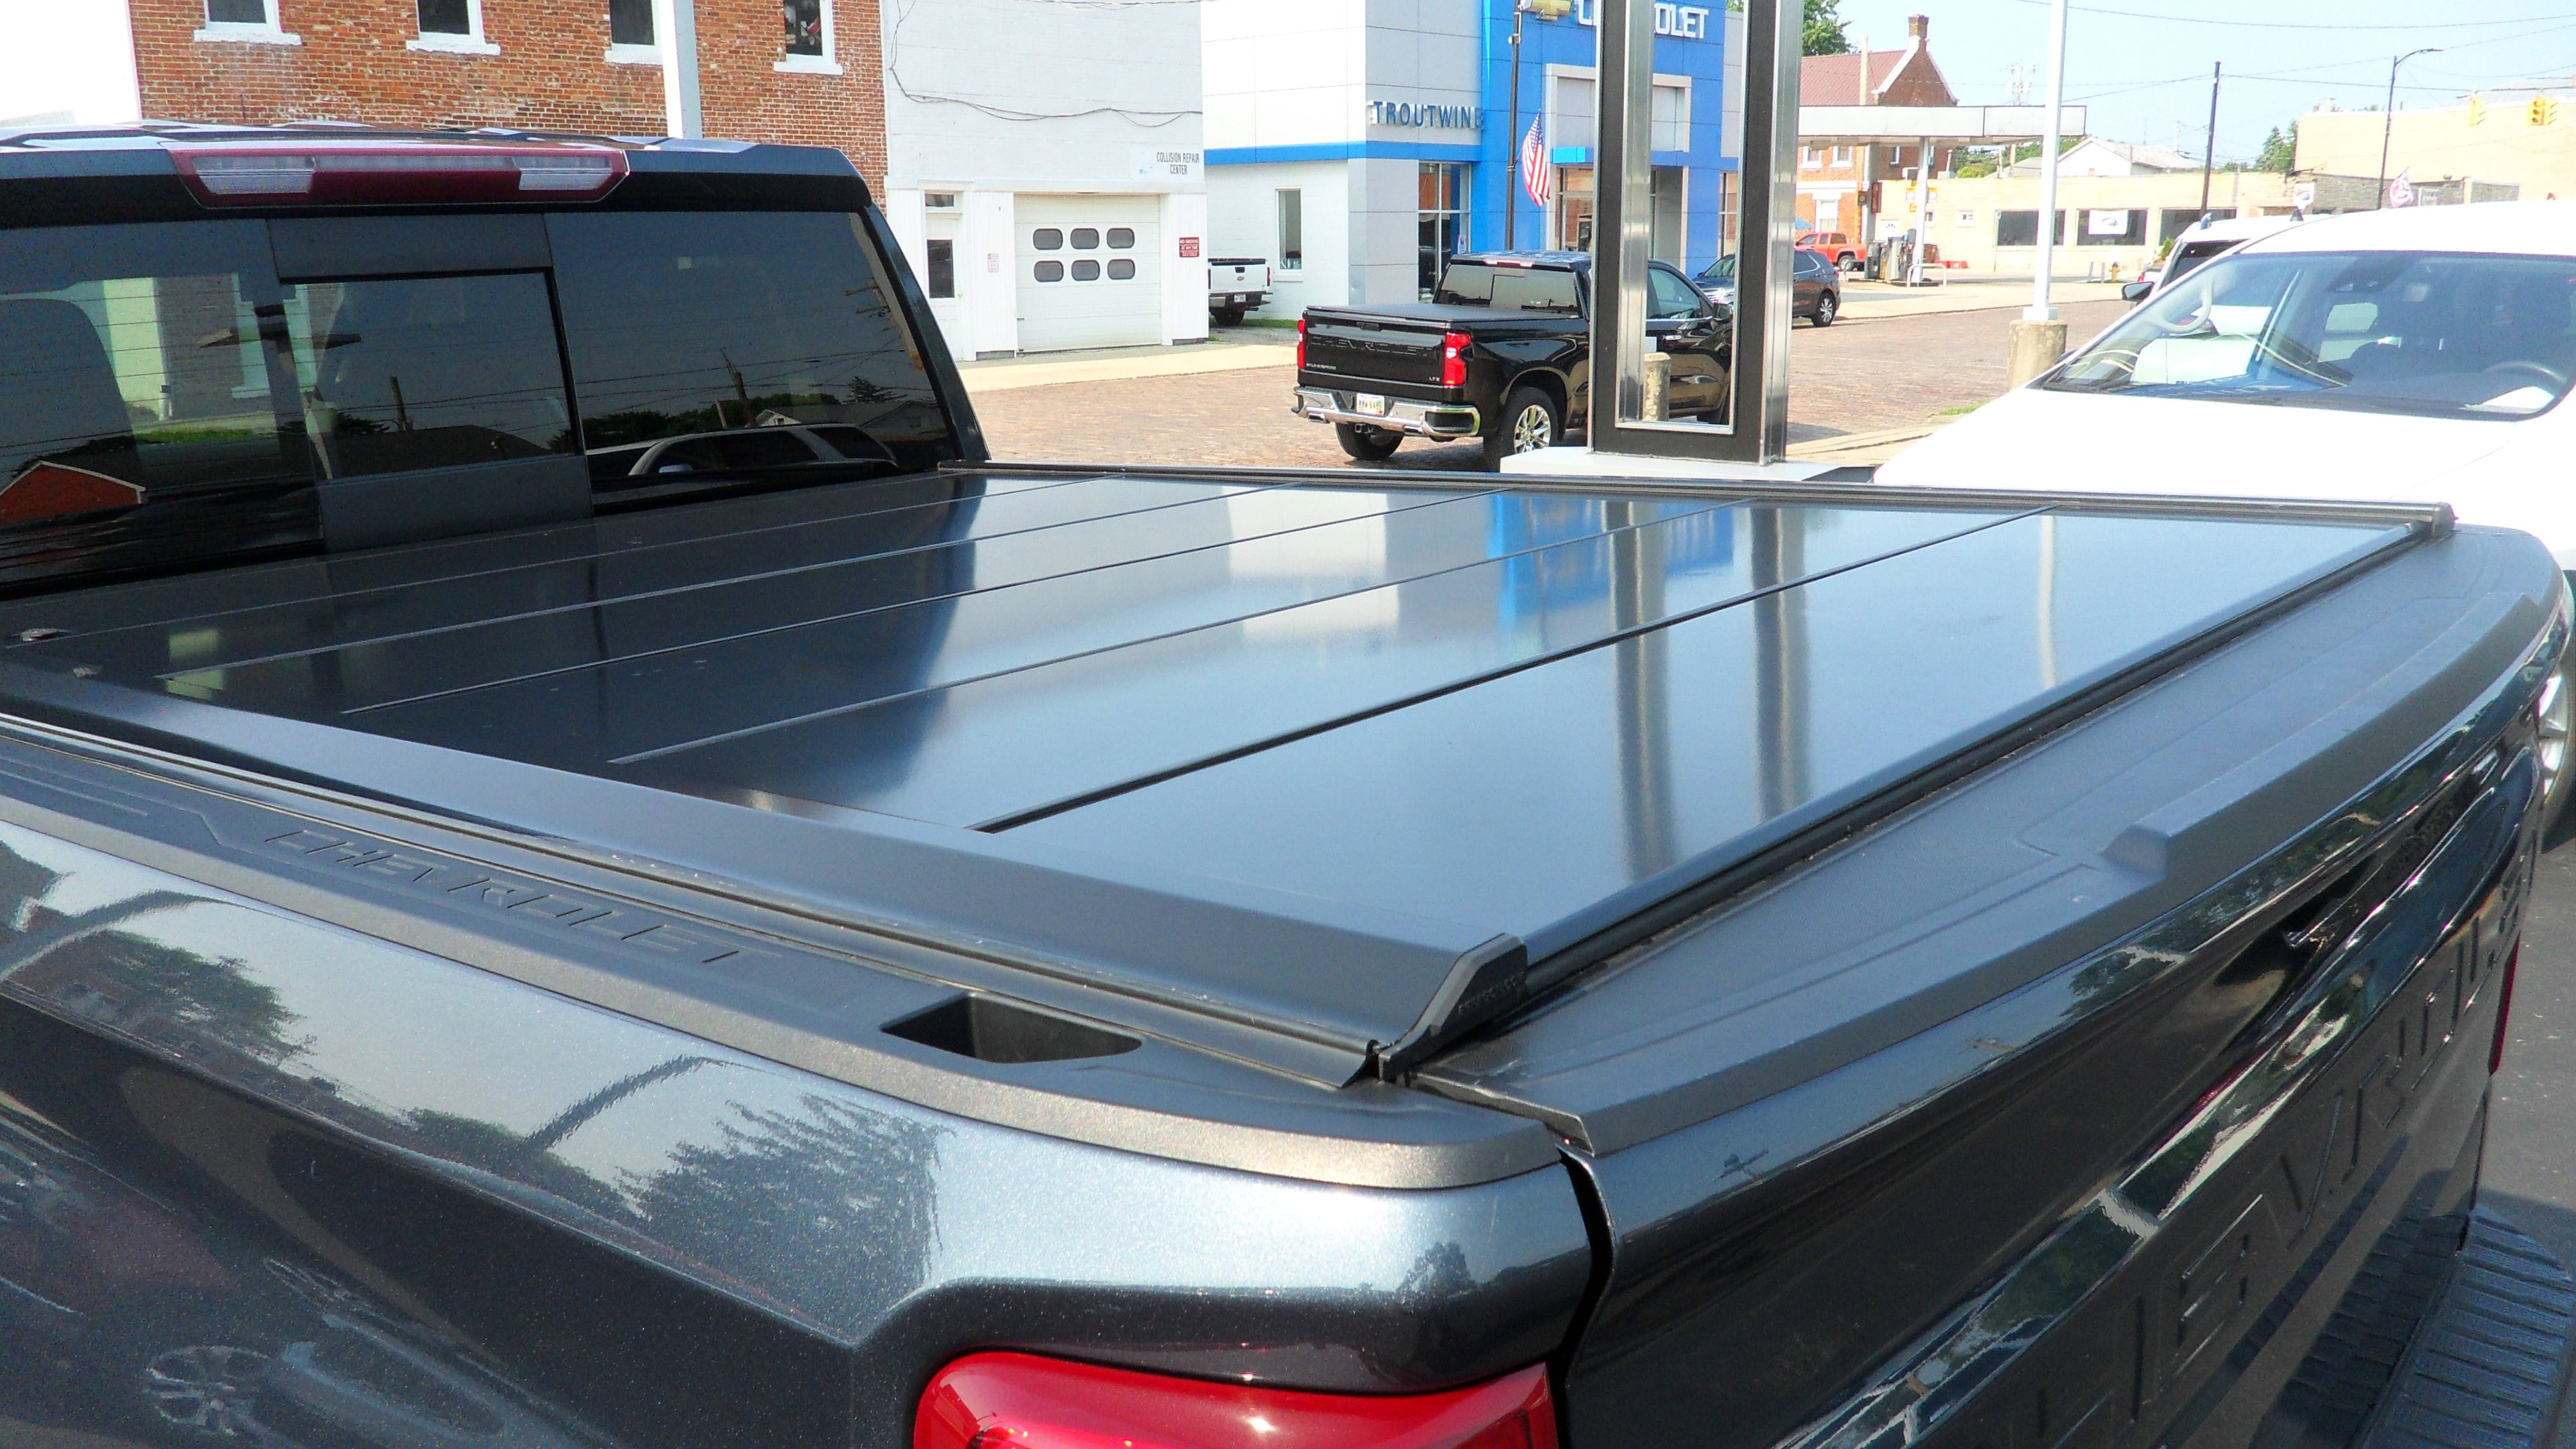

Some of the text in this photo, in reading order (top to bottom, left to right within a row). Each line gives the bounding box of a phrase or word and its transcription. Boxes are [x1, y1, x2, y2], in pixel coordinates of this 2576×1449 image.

[1576, 0, 1709, 39] COLET
[1373, 101, 1483, 129] TROUTWINE
[1157, 152, 1200, 164] COLLISION REPAIR
[1169, 164, 1187, 174] CENTER
[264, 830, 782, 963] CHEVROLET
